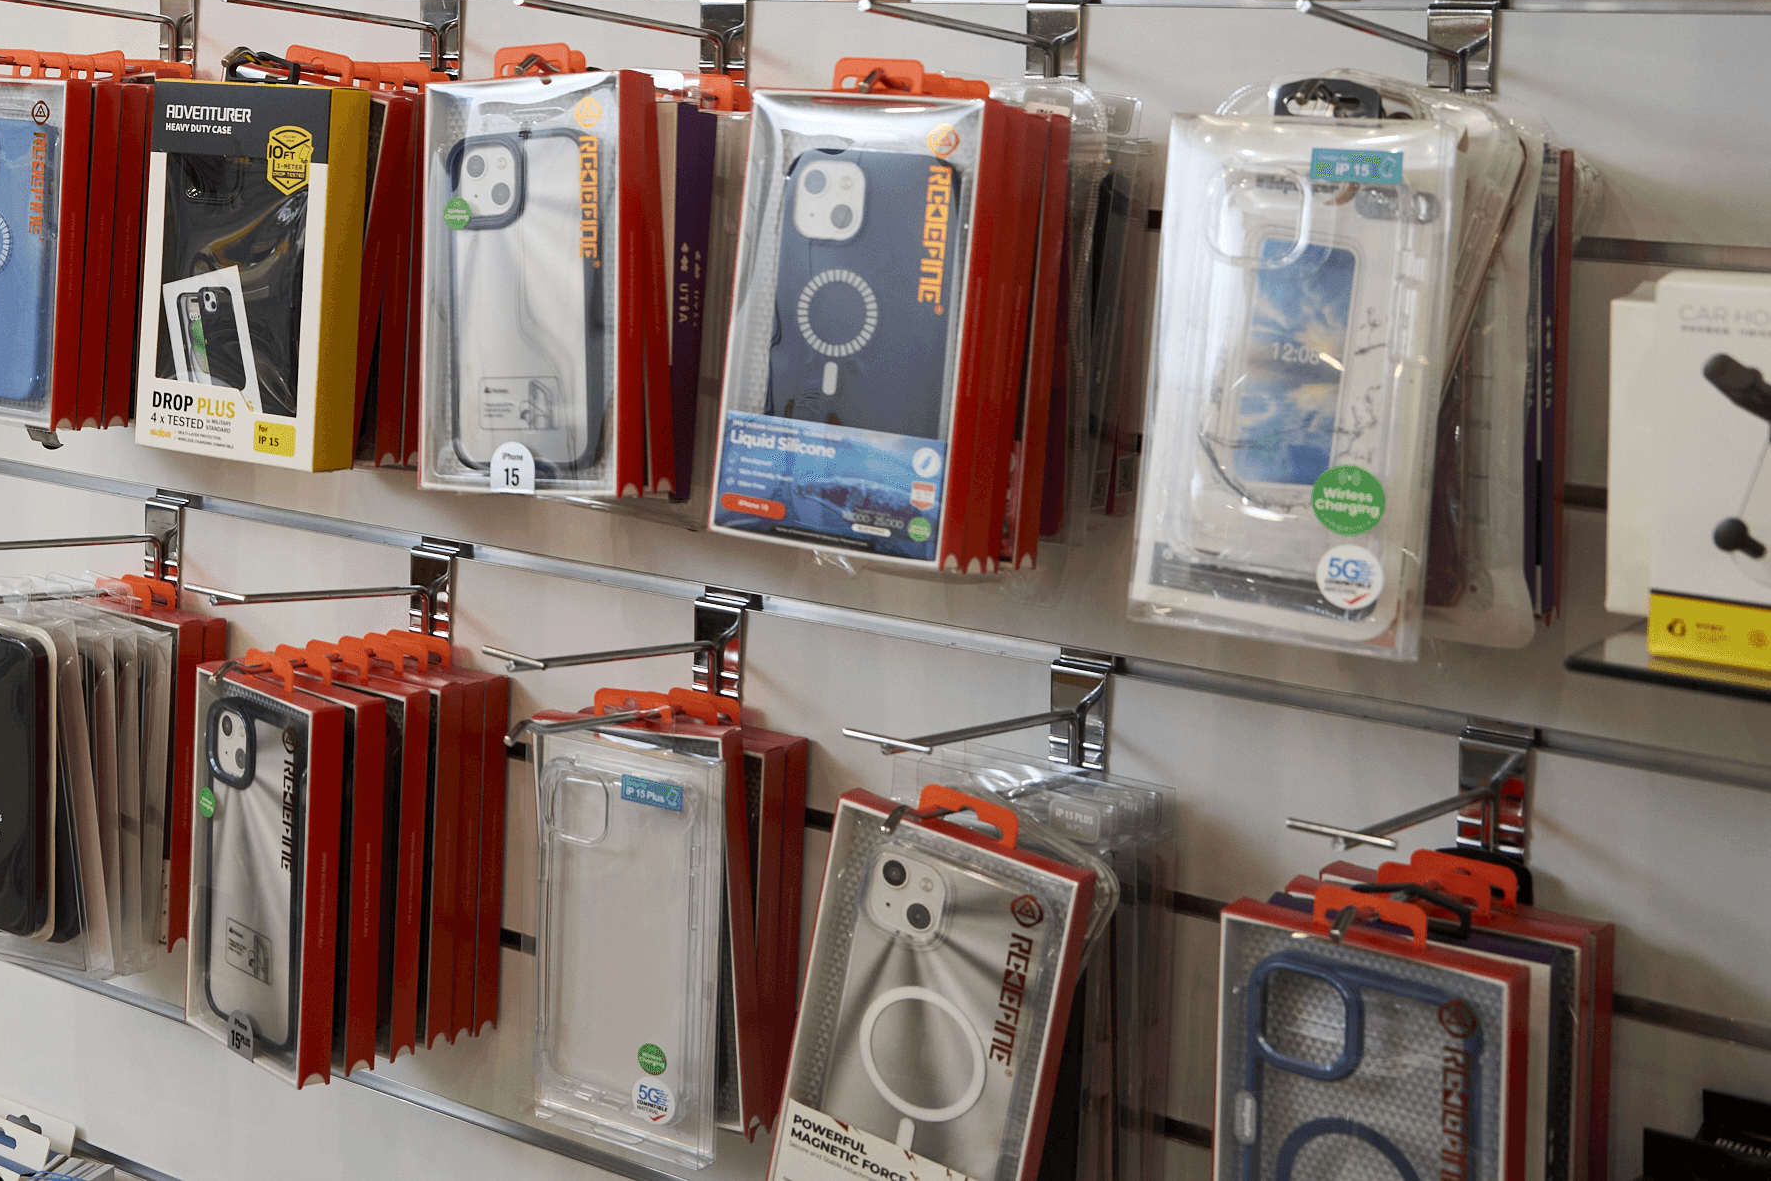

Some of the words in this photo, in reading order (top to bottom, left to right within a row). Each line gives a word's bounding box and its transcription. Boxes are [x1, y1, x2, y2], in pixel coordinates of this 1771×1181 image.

[165, 104, 252, 123] ADVENTURER
[165, 123, 189, 132] HEAVY
[191, 124, 208, 133] DUTY
[209, 125, 232, 135] CASE
[1354, 161, 1370, 178] 15
[1271, 342, 1319, 365] 12:08
[152, 390, 194, 413] DROP
[197, 398, 235, 419] PLUS
[150, 413, 157, 423] 4
[167, 414, 204, 430] TESTED
[206, 424, 231, 434] STANDARD
[258, 424, 268, 433] for
[258, 436, 267, 445] IP
[269, 437, 279, 447] 15
[730, 429, 775, 450] Liquid
[778, 434, 836, 459] Silicone
[502, 452, 524, 461] iPhone
[504, 467, 519, 486] 15
[1314, 497, 1380, 519] Charging
[1327, 556, 1360, 580] 5G
[636, 788, 645, 798] 15
[646, 790, 665, 803] Plus
[231, 1030, 241, 1050] 15
[638, 1084, 659, 1104] 5G
[636, 1099, 668, 1113] COMPATIBLE
[793, 1114, 868, 1156] POWERFUL
[790, 1127, 860, 1168] MAGNETIC
[862, 1156, 908, 1181] FORCE
